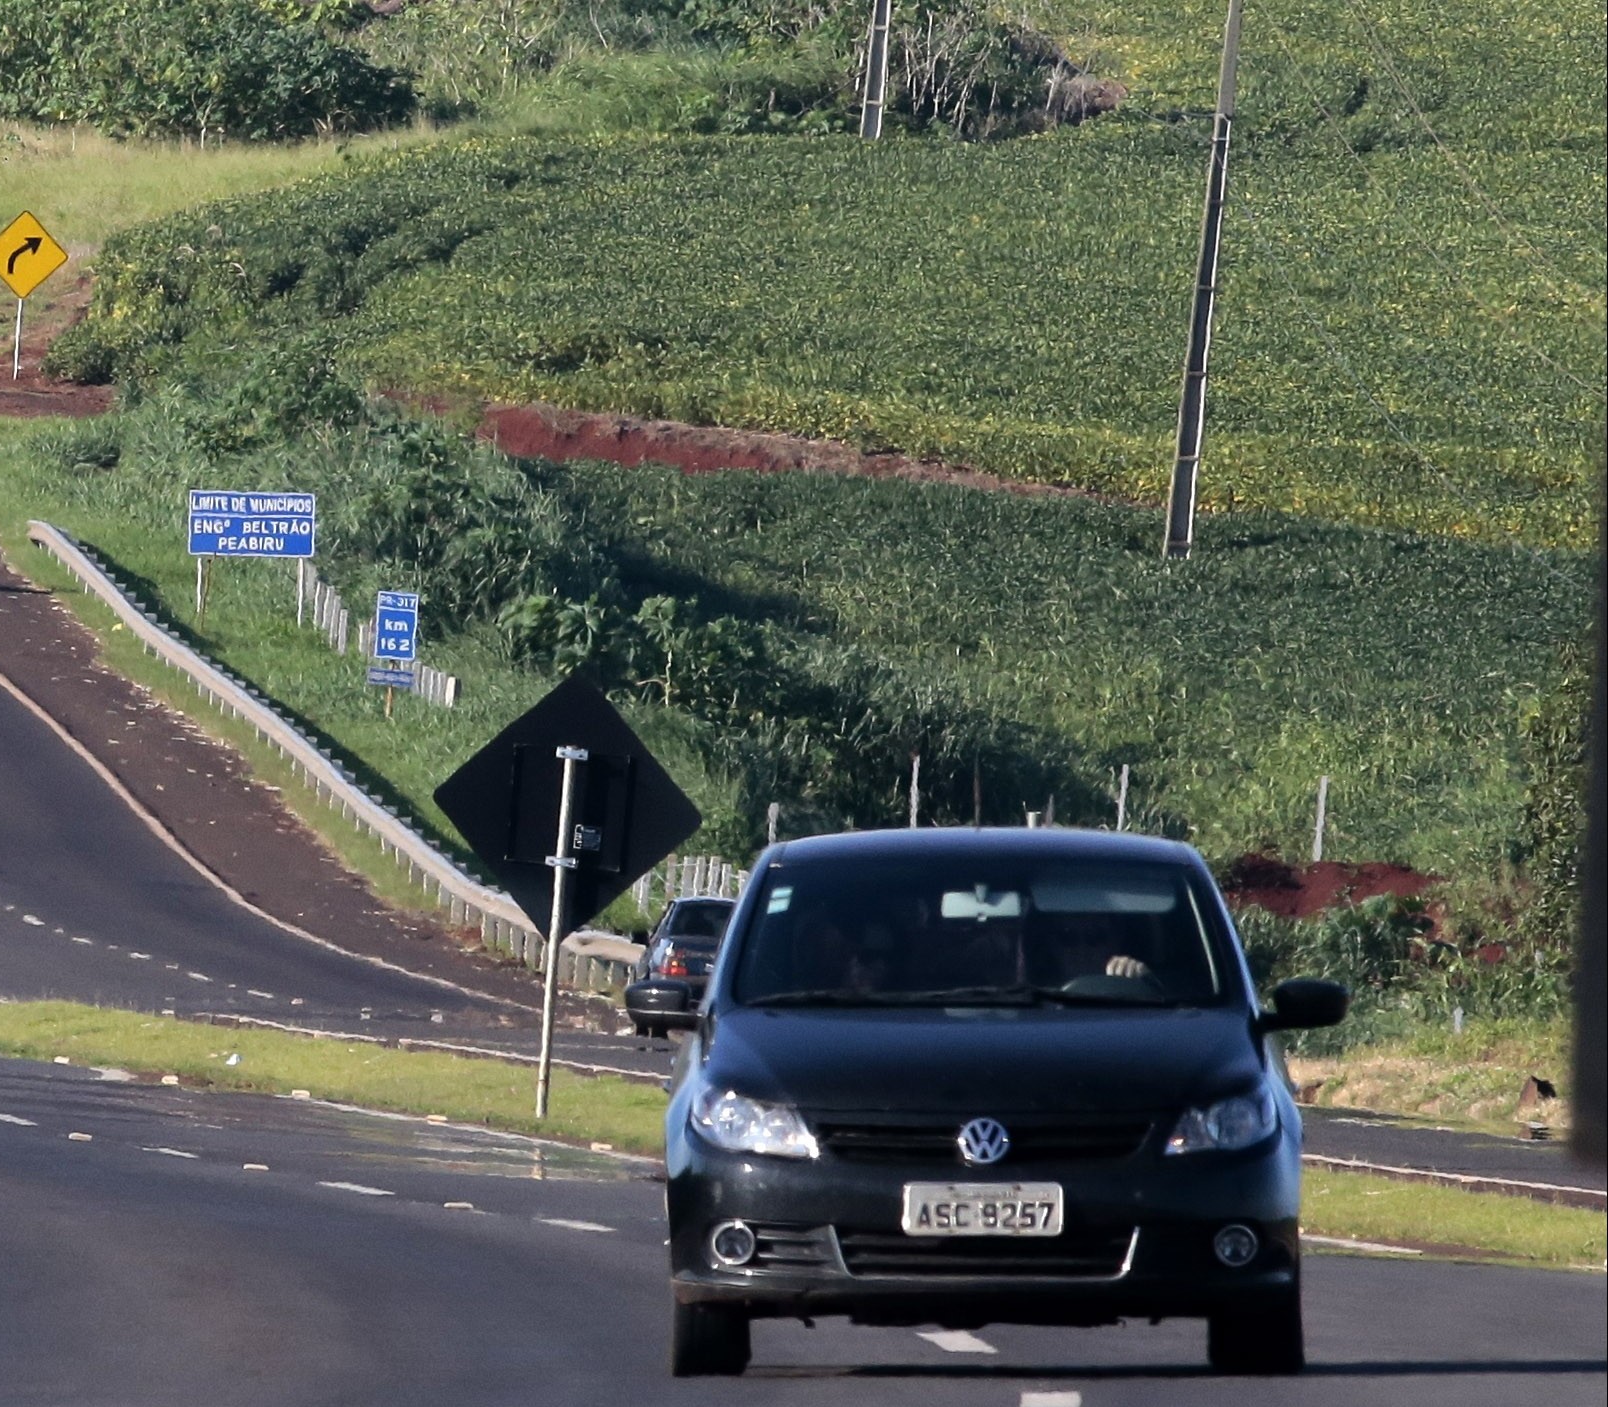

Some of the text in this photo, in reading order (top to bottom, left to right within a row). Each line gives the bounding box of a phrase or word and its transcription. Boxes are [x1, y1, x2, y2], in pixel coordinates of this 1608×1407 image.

[192, 495, 228, 511] LIMITE
[231, 496, 247, 513] DE
[242, 519, 311, 535] BELTRÃO
[218, 536, 284, 551] PEABIRU
[384, 619, 409, 632] km
[380, 638, 410, 651] 162
[917, 1202, 1055, 1229] ASC 9257
